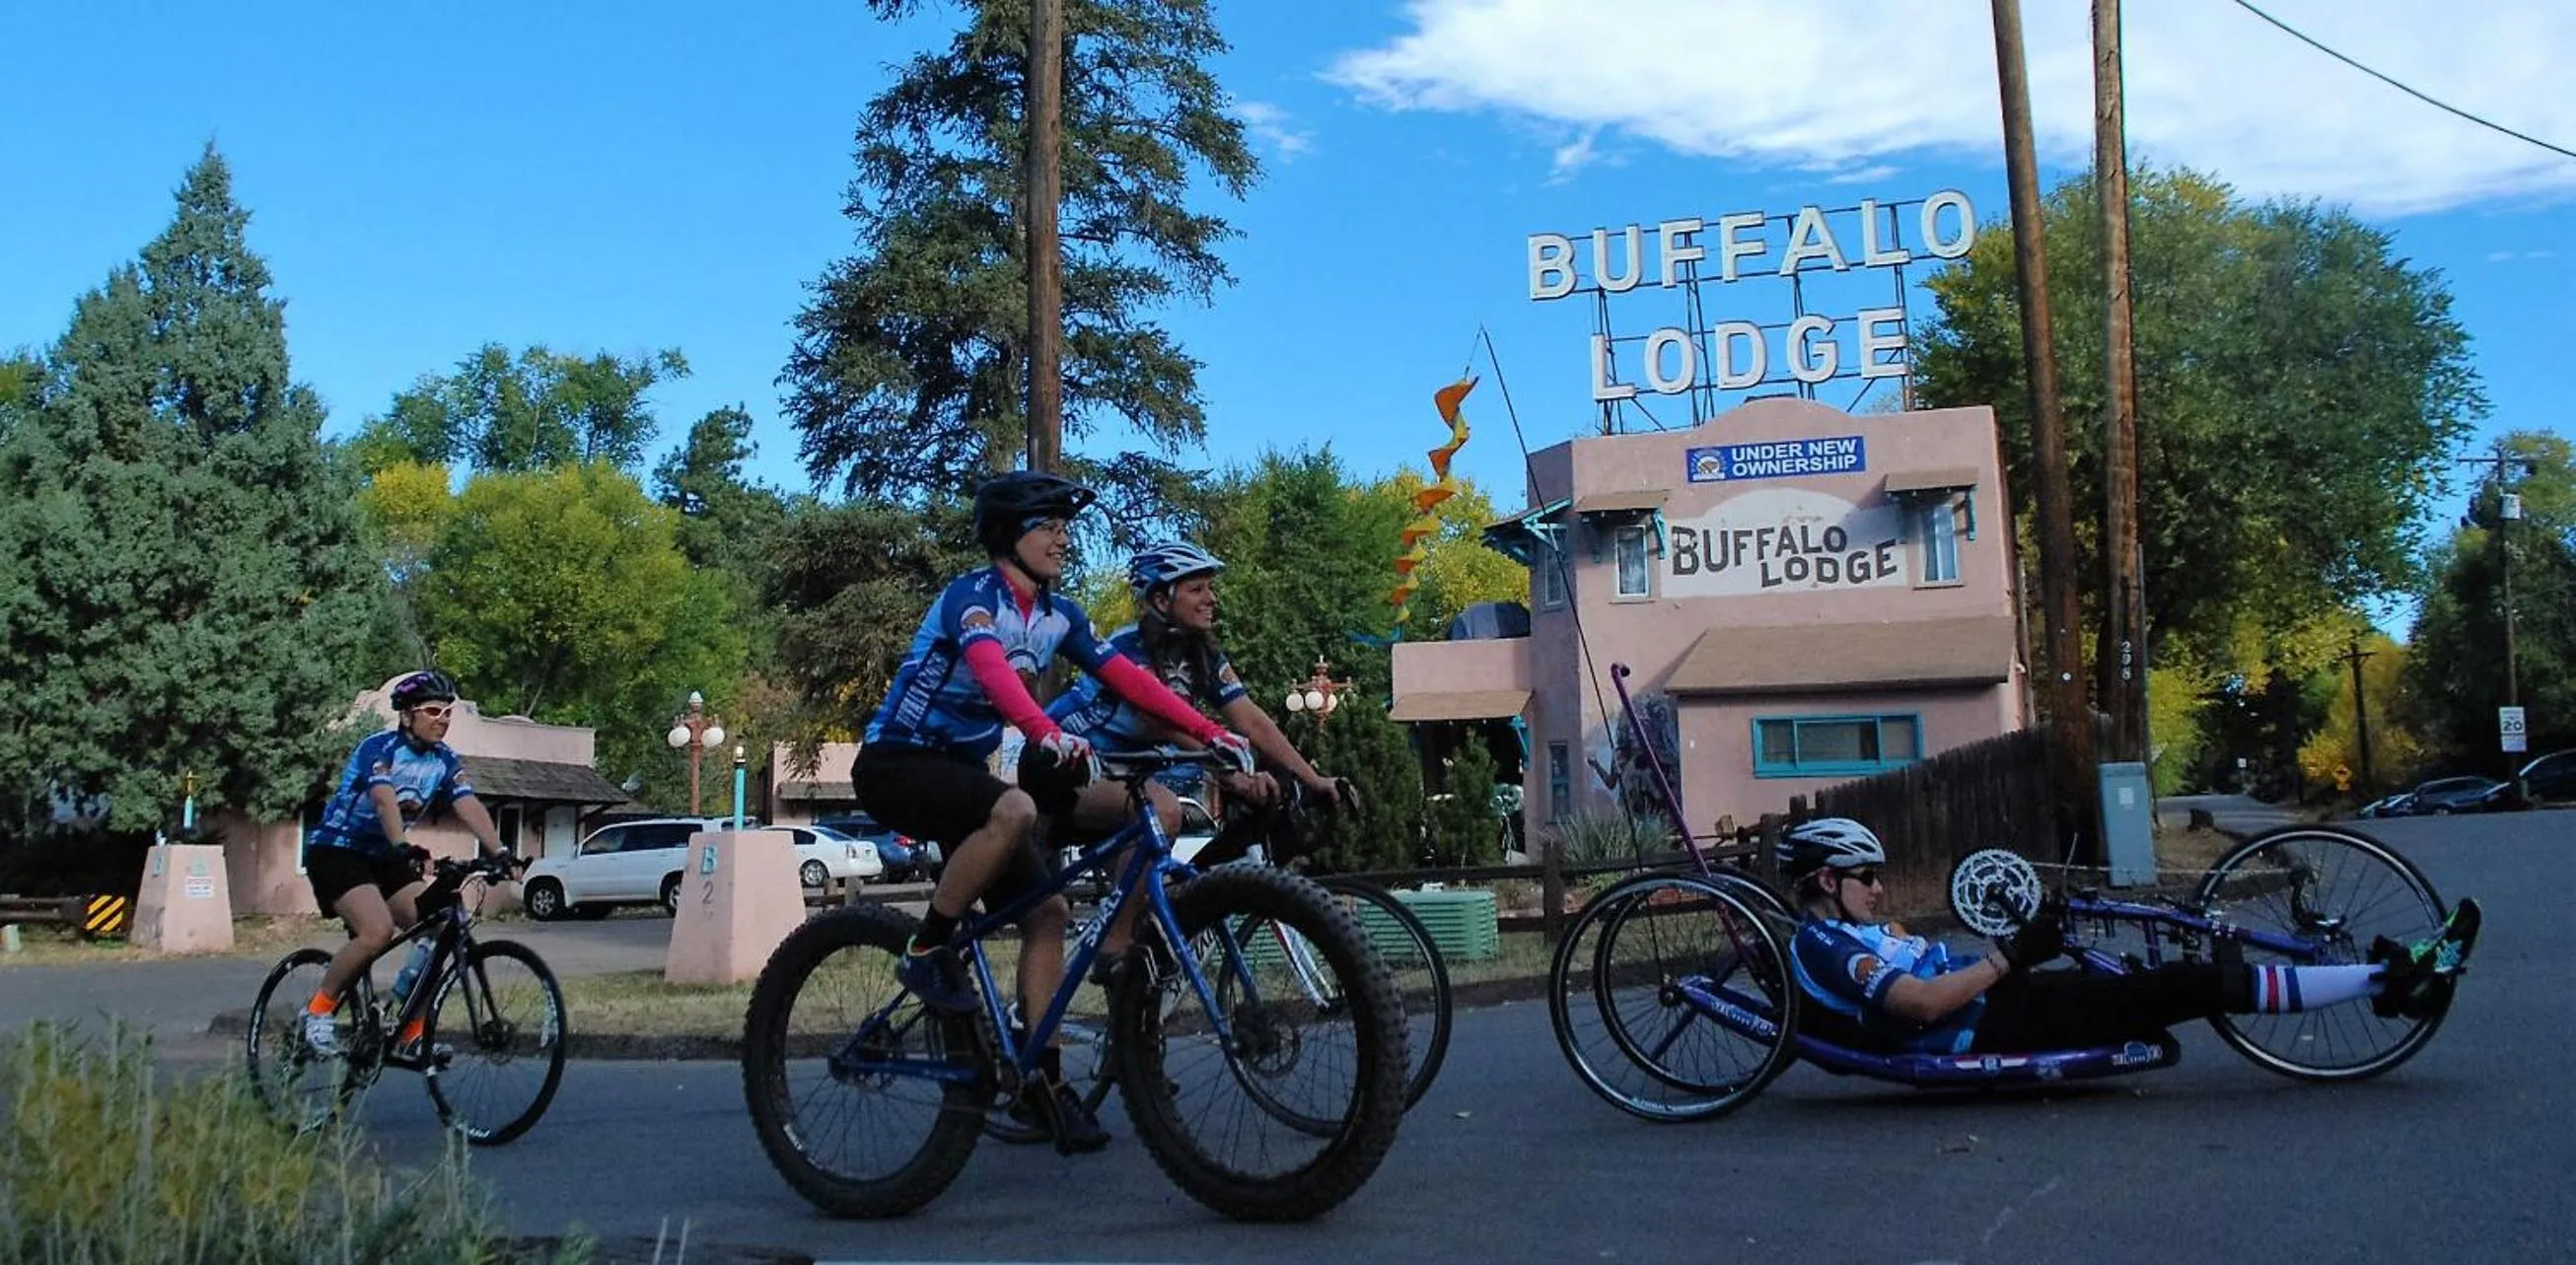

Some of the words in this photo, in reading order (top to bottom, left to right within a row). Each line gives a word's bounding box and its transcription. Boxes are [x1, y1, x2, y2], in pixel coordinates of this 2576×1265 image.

[1528, 189, 1975, 300] BUFFALO
[1591, 308, 1909, 401] LODGE
[1731, 444, 1803, 462] UNDER
[1809, 439, 1856, 457] NEW
[1732, 455, 1857, 477] OWNERSHIP
[1671, 525, 1847, 576] BUFFALO
[1760, 538, 1898, 589] LODGE
[2503, 720, 2523, 732] 20
